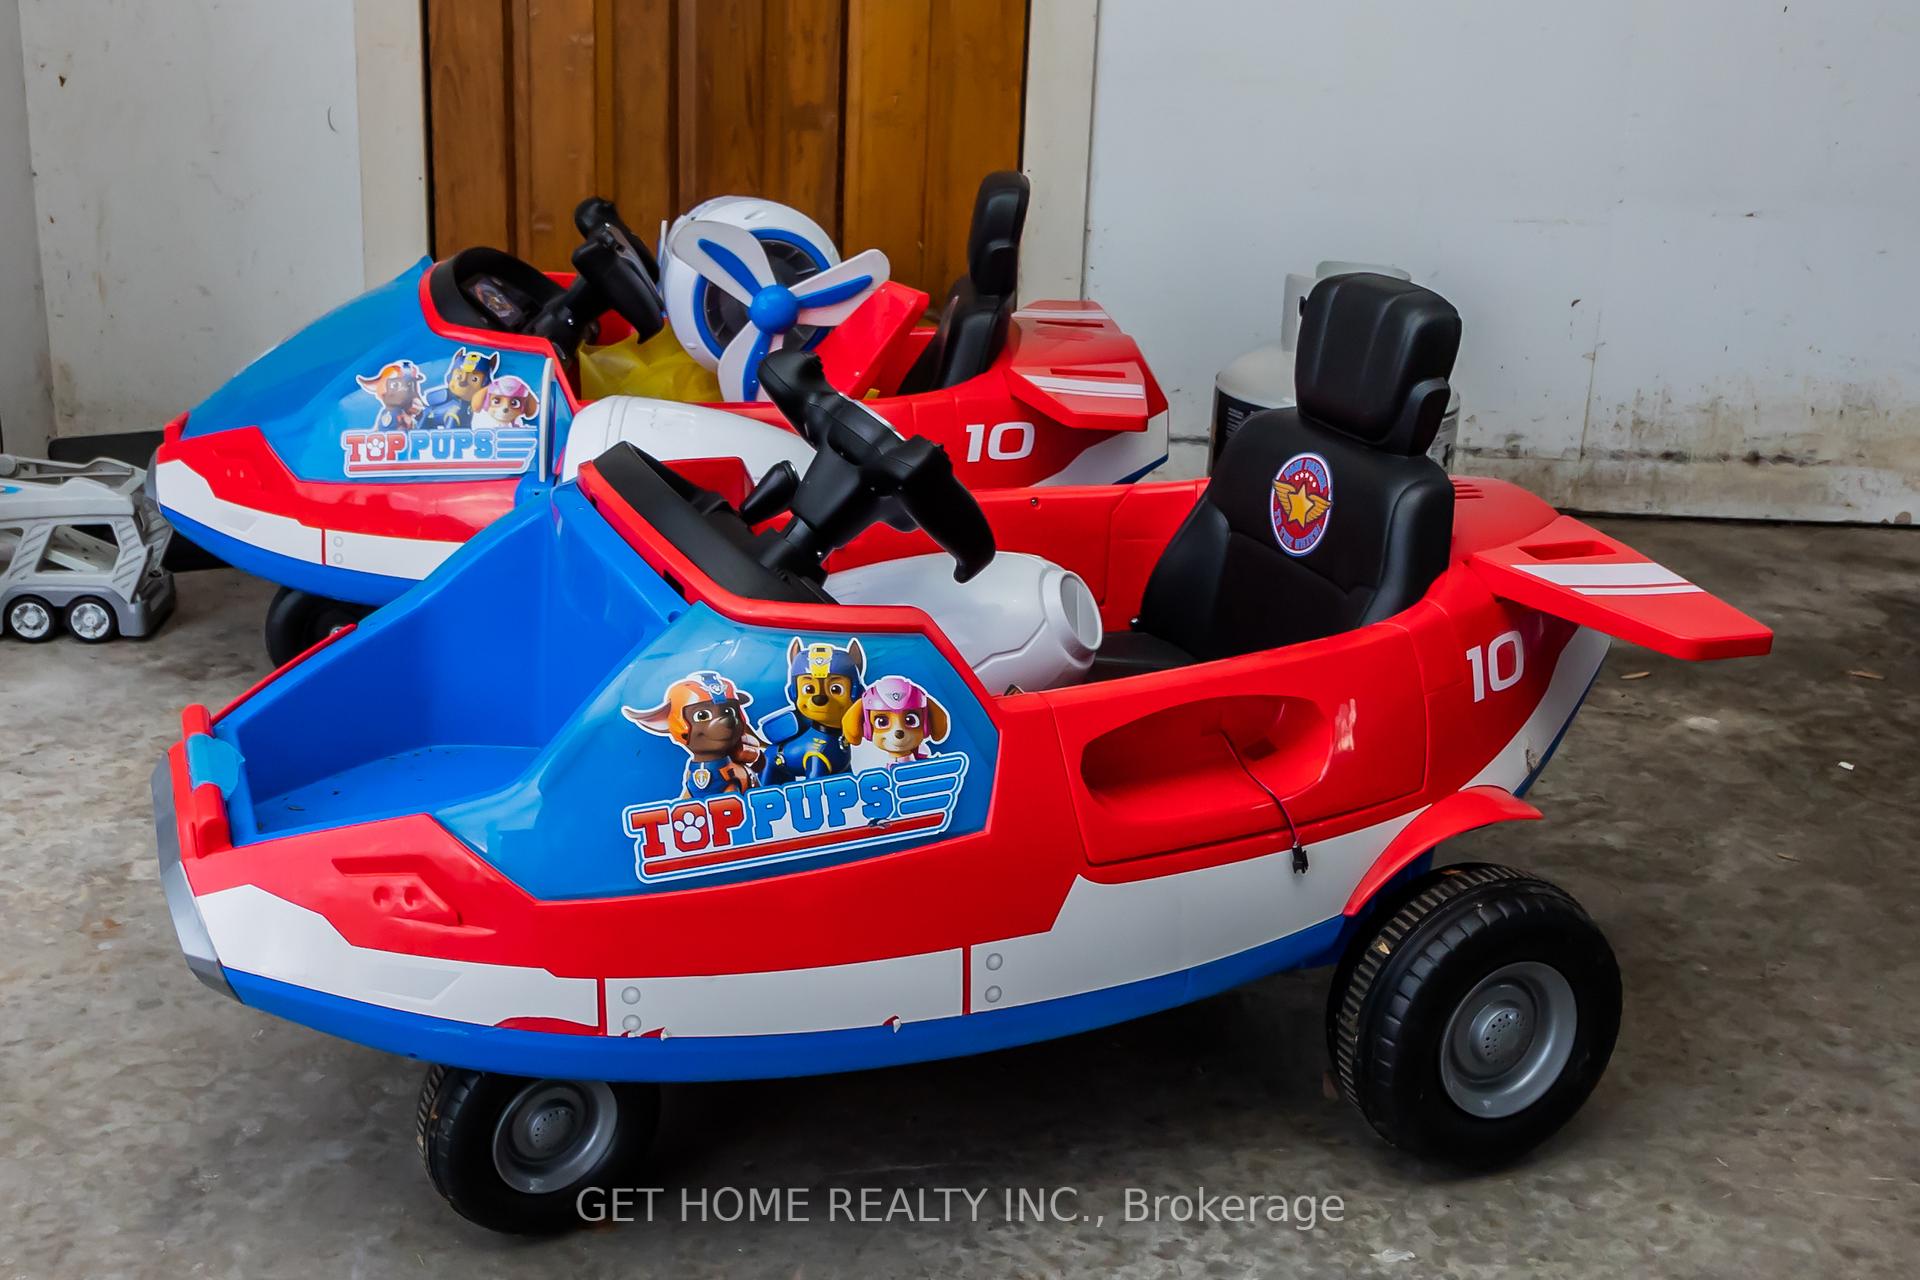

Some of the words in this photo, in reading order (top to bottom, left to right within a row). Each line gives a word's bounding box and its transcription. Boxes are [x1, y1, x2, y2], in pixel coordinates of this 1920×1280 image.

[345, 432, 406, 462] TOP
[409, 429, 494, 460] PUPS
[966, 421, 1036, 463] 10
[1465, 630, 1525, 703] 10
[630, 795, 746, 859] TOP
[750, 769, 894, 840] PUPS
